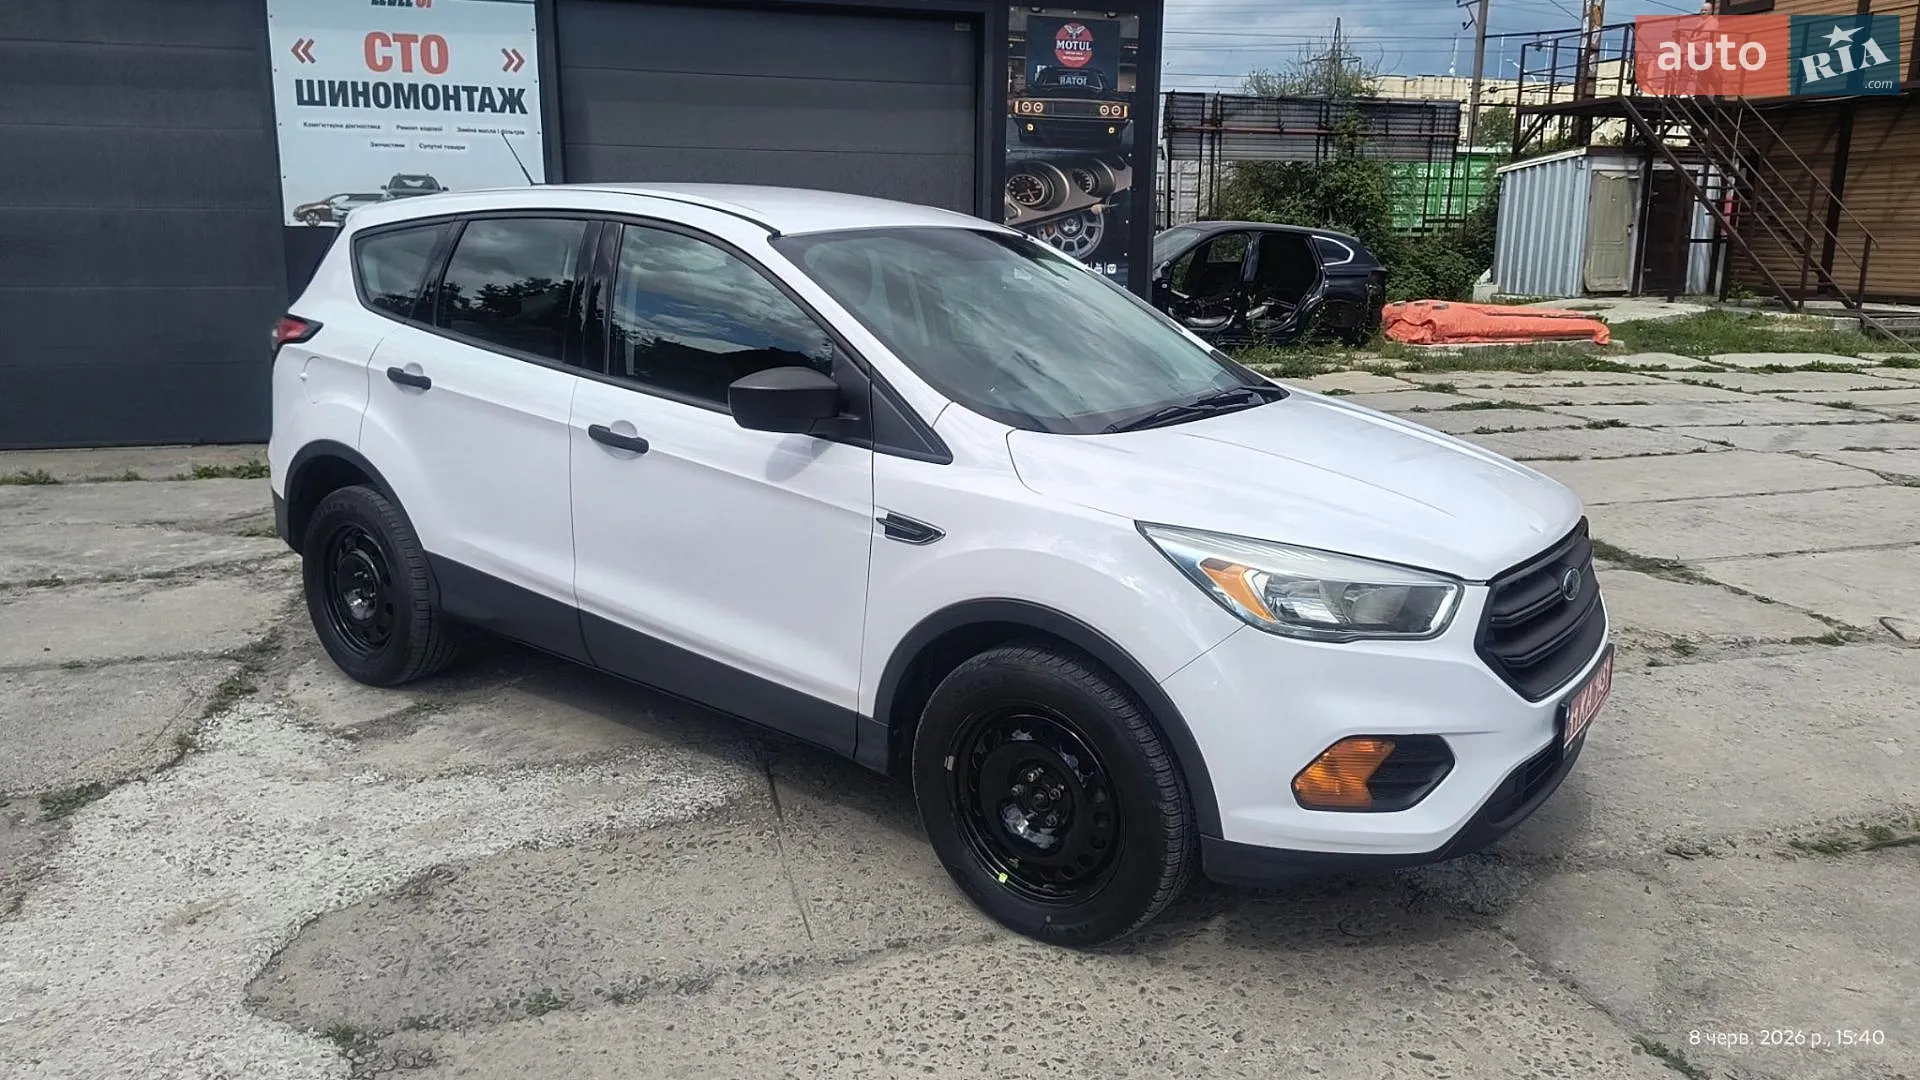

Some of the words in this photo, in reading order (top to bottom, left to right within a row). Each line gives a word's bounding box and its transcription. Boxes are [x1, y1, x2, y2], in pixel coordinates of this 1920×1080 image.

[363, 31, 449, 75] СТО
[1056, 39, 1092, 51] MOTUL
[295, 79, 528, 115] ШИНОМОНТАЖ
